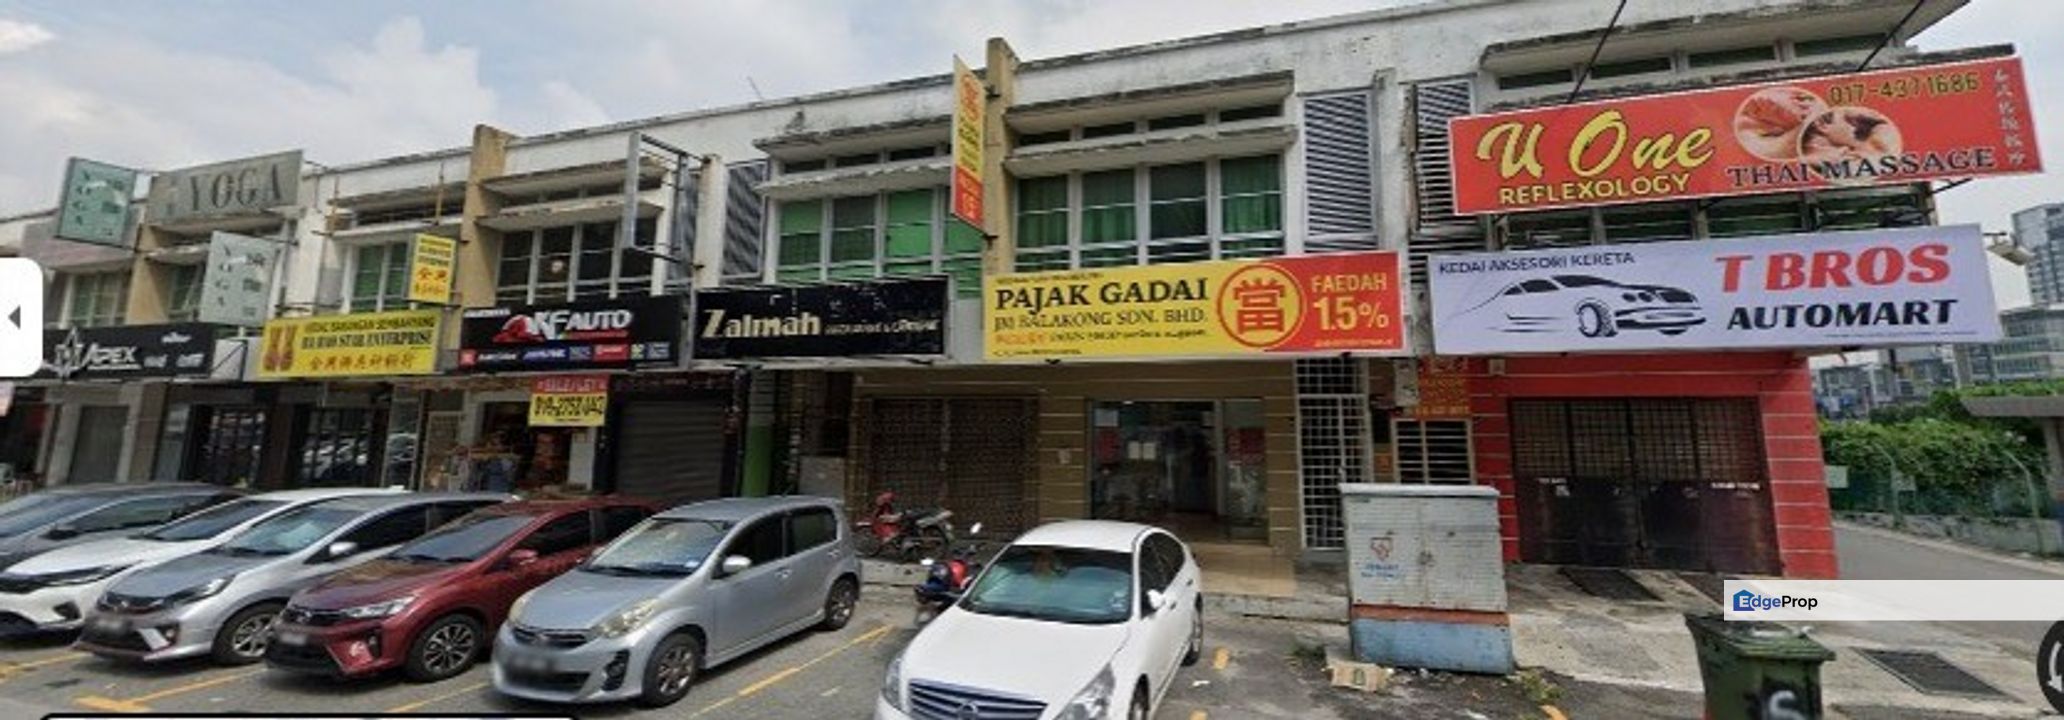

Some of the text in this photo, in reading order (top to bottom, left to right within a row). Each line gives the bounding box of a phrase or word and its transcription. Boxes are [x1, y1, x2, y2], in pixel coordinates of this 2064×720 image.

[1475, 109, 1716, 179] U One
[1727, 147, 1997, 189] THAI MASSAGE
[188, 163, 284, 211] YOGA
[1498, 173, 1692, 206] REFLEXOLOGY
[1439, 252, 1636, 274] KEDAI AKSESORI KERETA
[1714, 243, 1952, 294] T BROS
[995, 277, 1209, 315] PAJAK GADAI
[1311, 272, 1388, 294] FAEDAH
[702, 309, 821, 338] Zalmah
[1232, 276, 1287, 336] 當
[1312, 296, 1390, 331] 1.5%
[1726, 298, 1959, 331] AUTOMART
